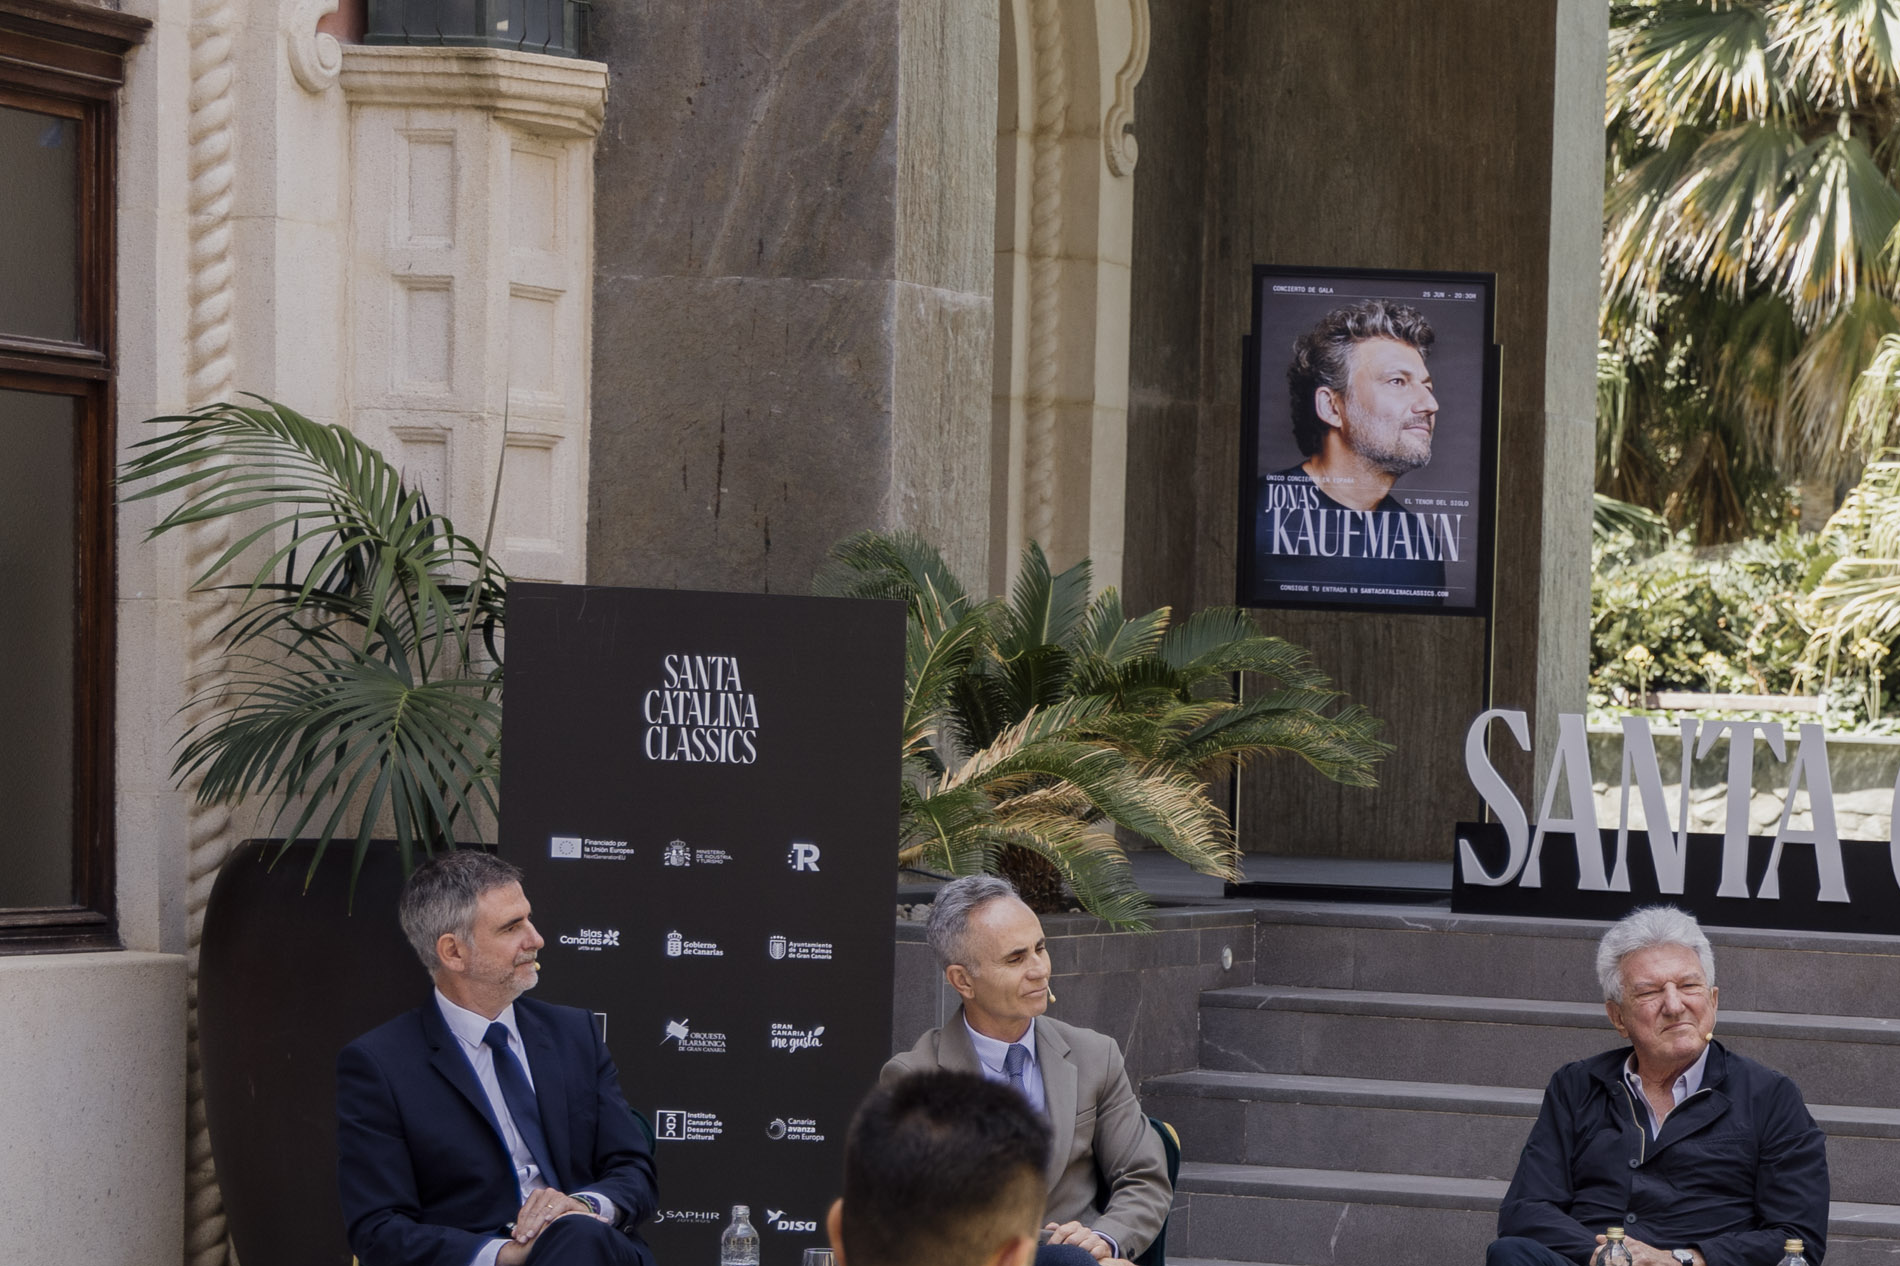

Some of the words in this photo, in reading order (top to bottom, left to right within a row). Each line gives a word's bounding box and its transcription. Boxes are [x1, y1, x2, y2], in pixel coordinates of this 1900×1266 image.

[1273, 285, 1306, 293] CONCIERTO
[1265, 483, 1320, 513] JONAS
[1450, 499, 1469, 507] SIGLO
[1272, 507, 1462, 562] KAUFMANN
[1280, 584, 1309, 592] CONSIGUE
[664, 654, 742, 691] SANTA
[644, 689, 759, 728] CATALINA
[645, 726, 757, 764] CLASSICS
[1459, 709, 1851, 903] SANTA
[609, 847, 634, 855] Europea
[580, 929, 602, 938] Islas
[560, 935, 602, 945] Canarias
[683, 941, 717, 949] Gobierno
[788, 941, 832, 949] Ayuntamiento
[692, 948, 724, 956] Canarias
[771, 1037, 788, 1048] me
[789, 1030, 823, 1053] gusta
[666, 1113, 677, 1137] ICDC
[787, 1118, 816, 1126] Canarias
[801, 1134, 825, 1142] Europa
[666, 1210, 720, 1220] SAPHIR
